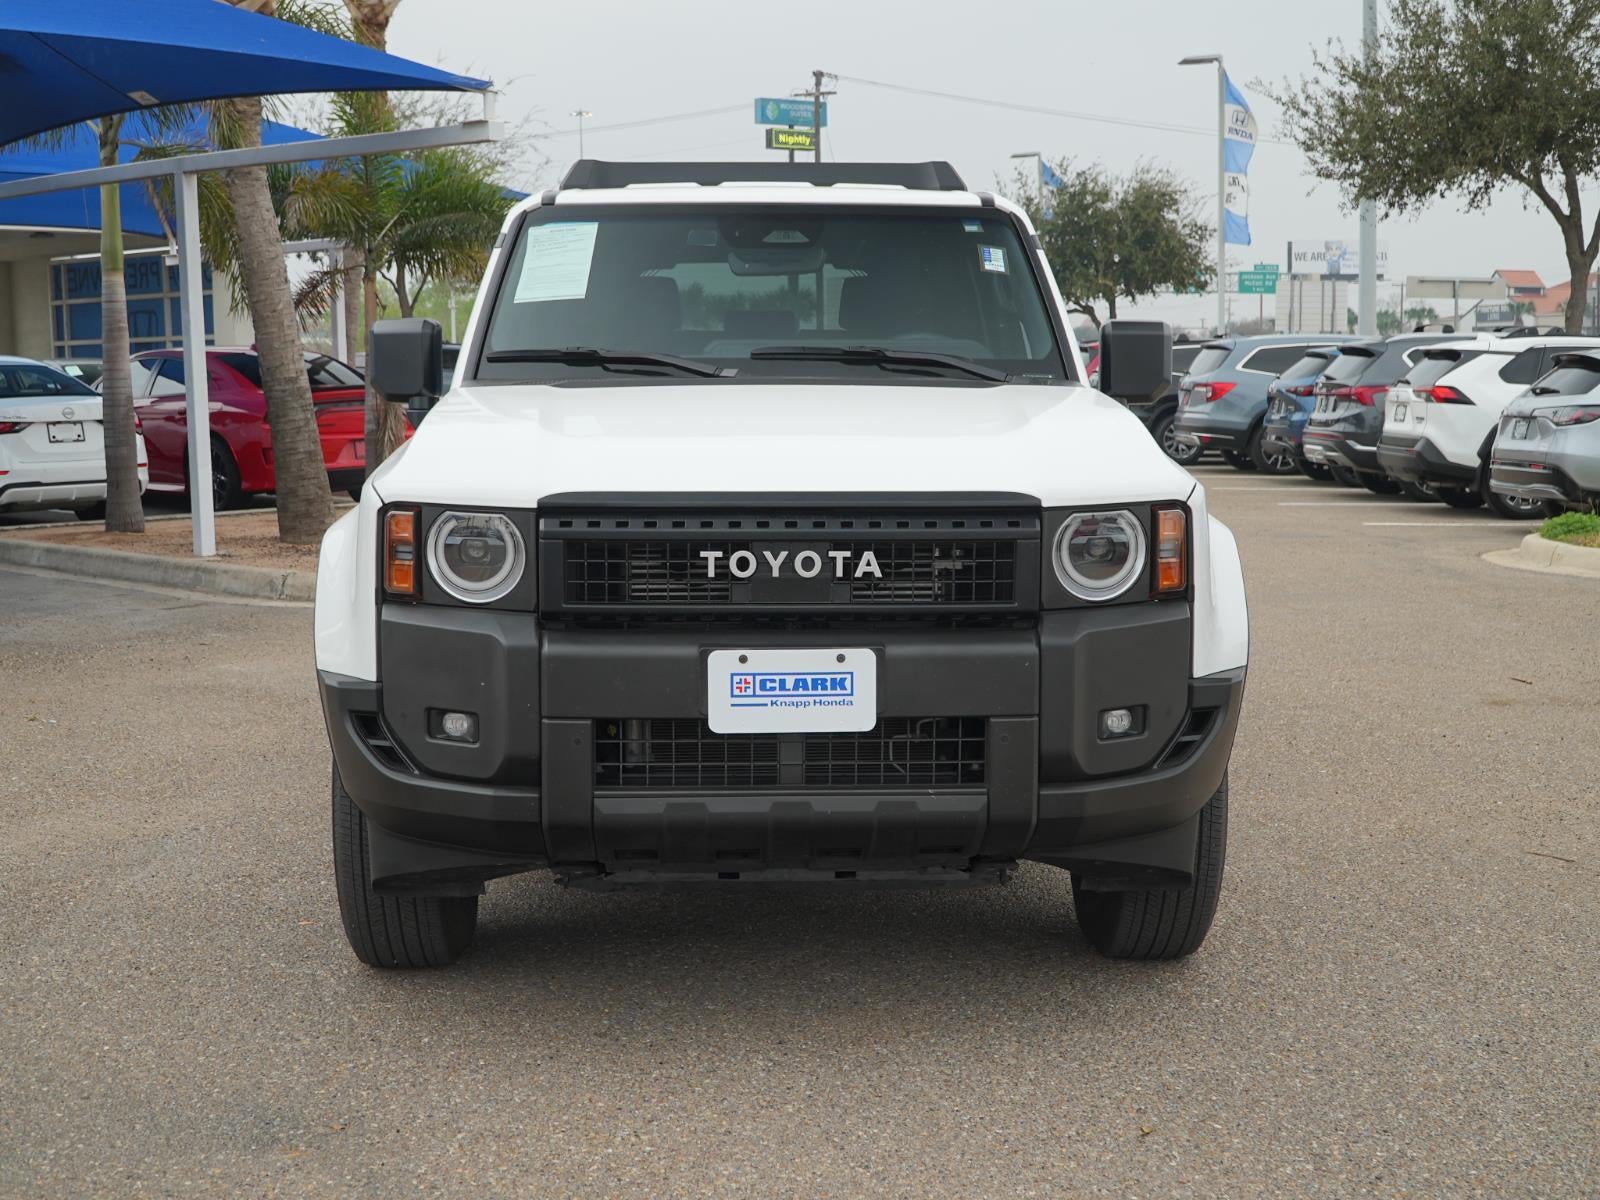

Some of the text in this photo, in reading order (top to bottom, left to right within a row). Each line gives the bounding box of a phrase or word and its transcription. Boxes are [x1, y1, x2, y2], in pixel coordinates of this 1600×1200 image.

[779, 134, 811, 146] Nightly
[1294, 252, 1308, 262] WE
[700, 550, 883, 579] TOYOTA
[759, 677, 848, 692] CLARK
[770, 698, 854, 709] Knapp Honda
